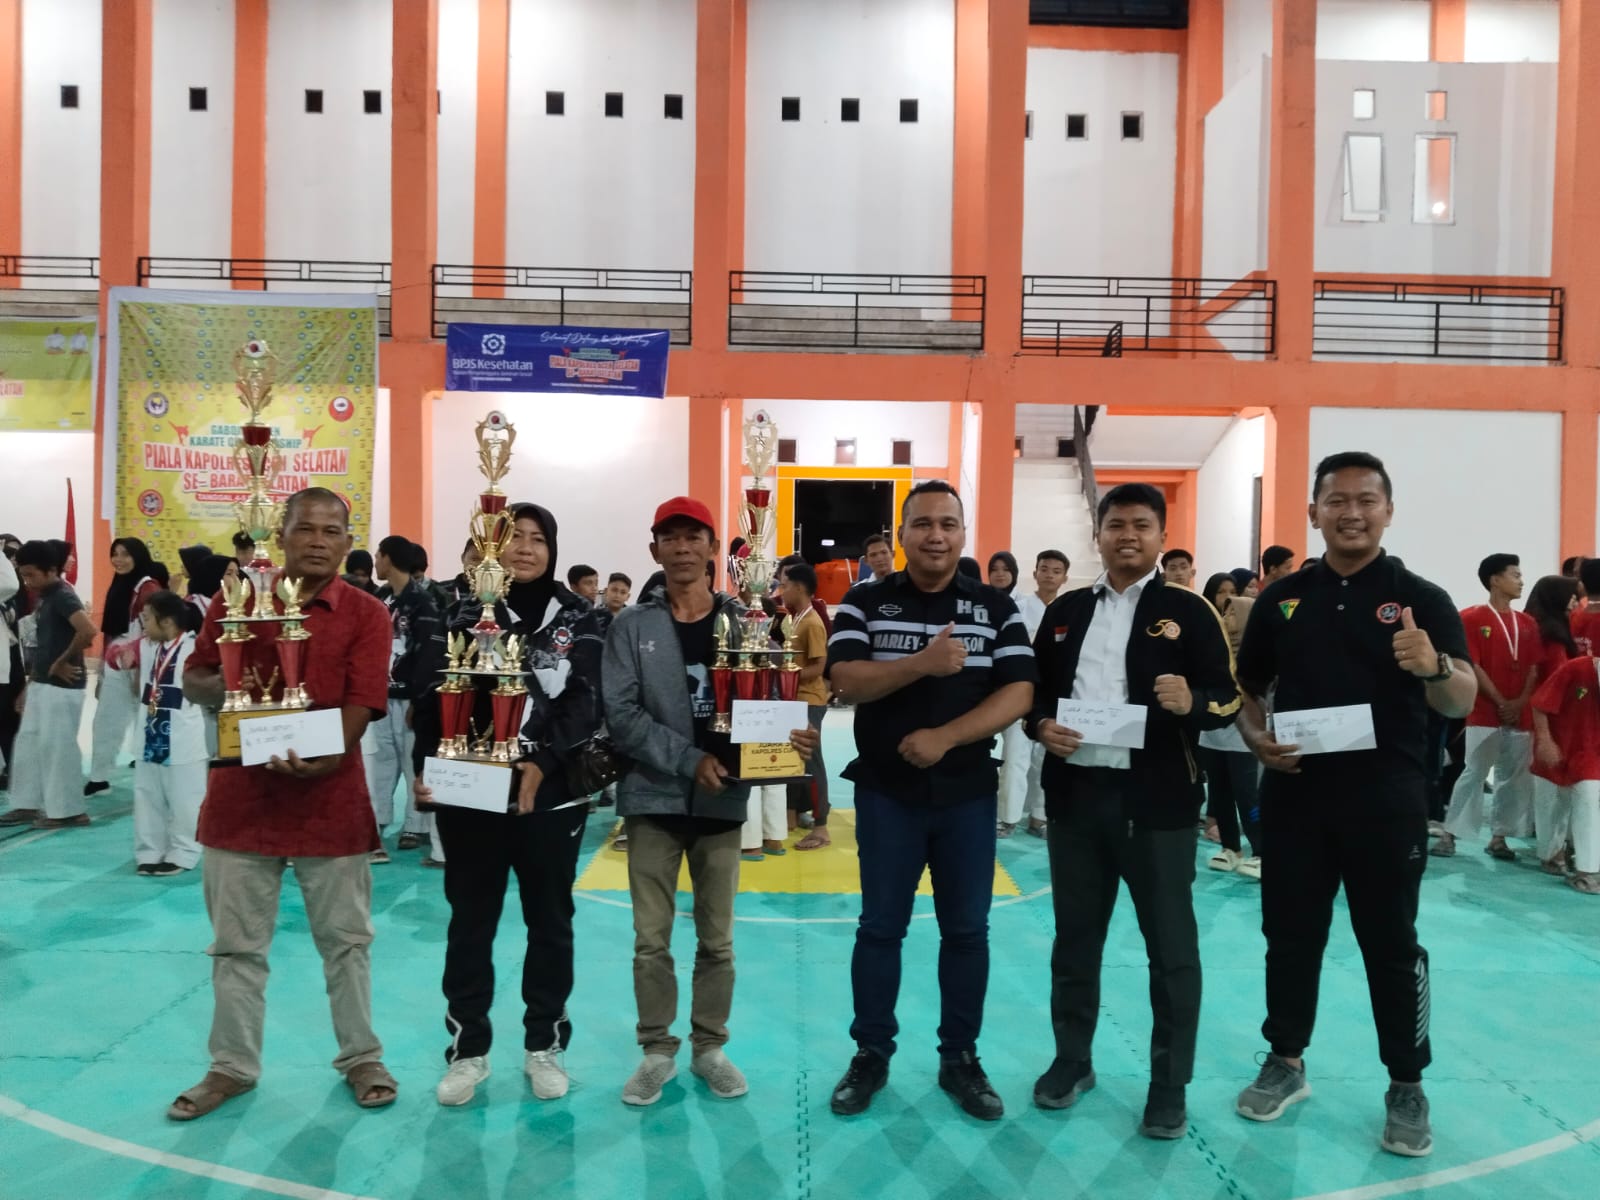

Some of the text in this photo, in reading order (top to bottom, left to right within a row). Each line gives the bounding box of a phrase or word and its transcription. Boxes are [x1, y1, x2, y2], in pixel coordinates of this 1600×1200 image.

[452, 358, 533, 370] BPJS Kesehatan
[189, 436, 224, 447] KARATE
[144, 443, 182, 469] PIALA
[185, 450, 250, 471] KAPOLRS
[292, 449, 347, 472] SELATAN
[210, 473, 246, 489] BARA
